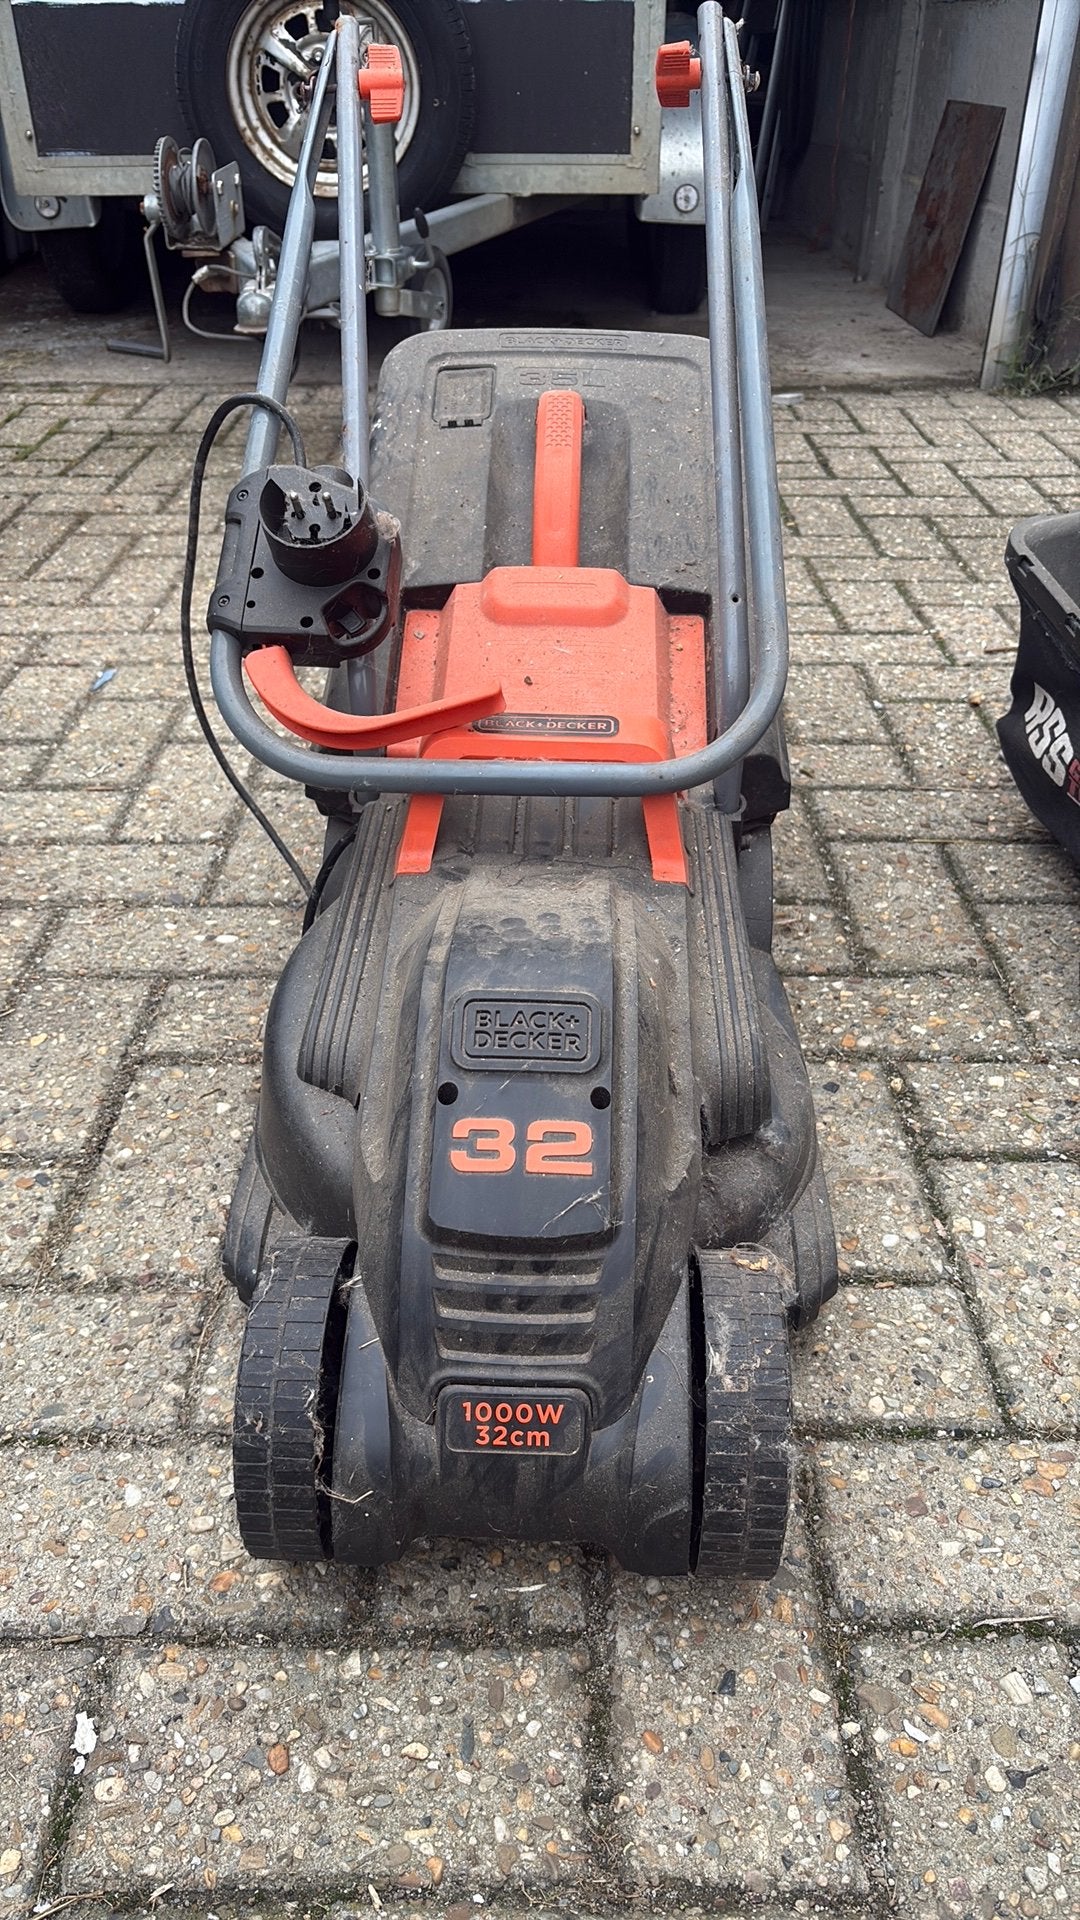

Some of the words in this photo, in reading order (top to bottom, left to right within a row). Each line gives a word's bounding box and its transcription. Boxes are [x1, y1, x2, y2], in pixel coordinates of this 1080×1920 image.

[484, 718, 608, 731] BLACK+DECKER
[475, 1009, 580, 1030] BLACK+
[474, 1030, 581, 1052] DECKER
[450, 1117, 593, 1176] 32
[462, 1401, 564, 1424] 1000W
[475, 1425, 550, 1447] 32cm
